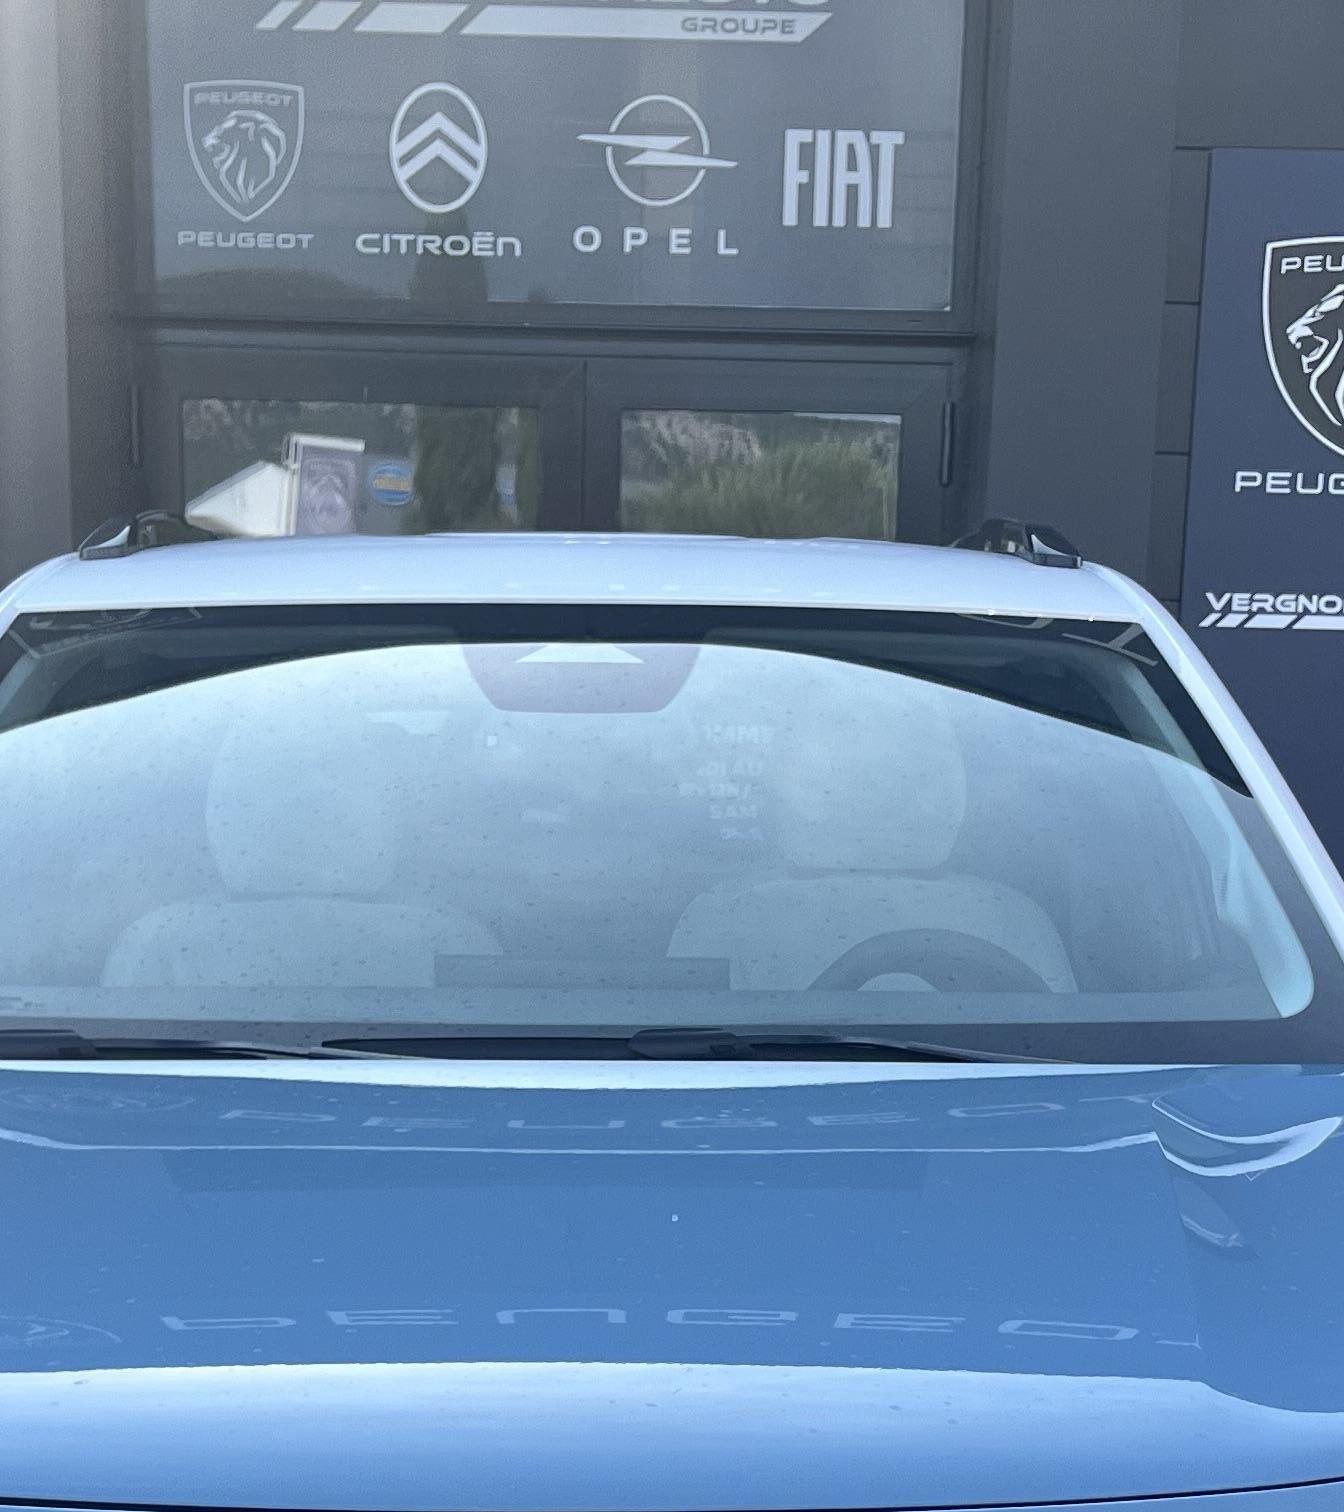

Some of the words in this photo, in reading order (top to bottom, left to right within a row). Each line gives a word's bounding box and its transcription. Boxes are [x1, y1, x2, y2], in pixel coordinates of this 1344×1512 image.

[680, 17, 796, 35] GROUPE
[193, 91, 294, 106] PEUGEOT
[783, 128, 906, 229] FIAT
[177, 230, 316, 249] PEUGEOT
[356, 231, 523, 257] CITROËN
[572, 225, 740, 256] OPEL
